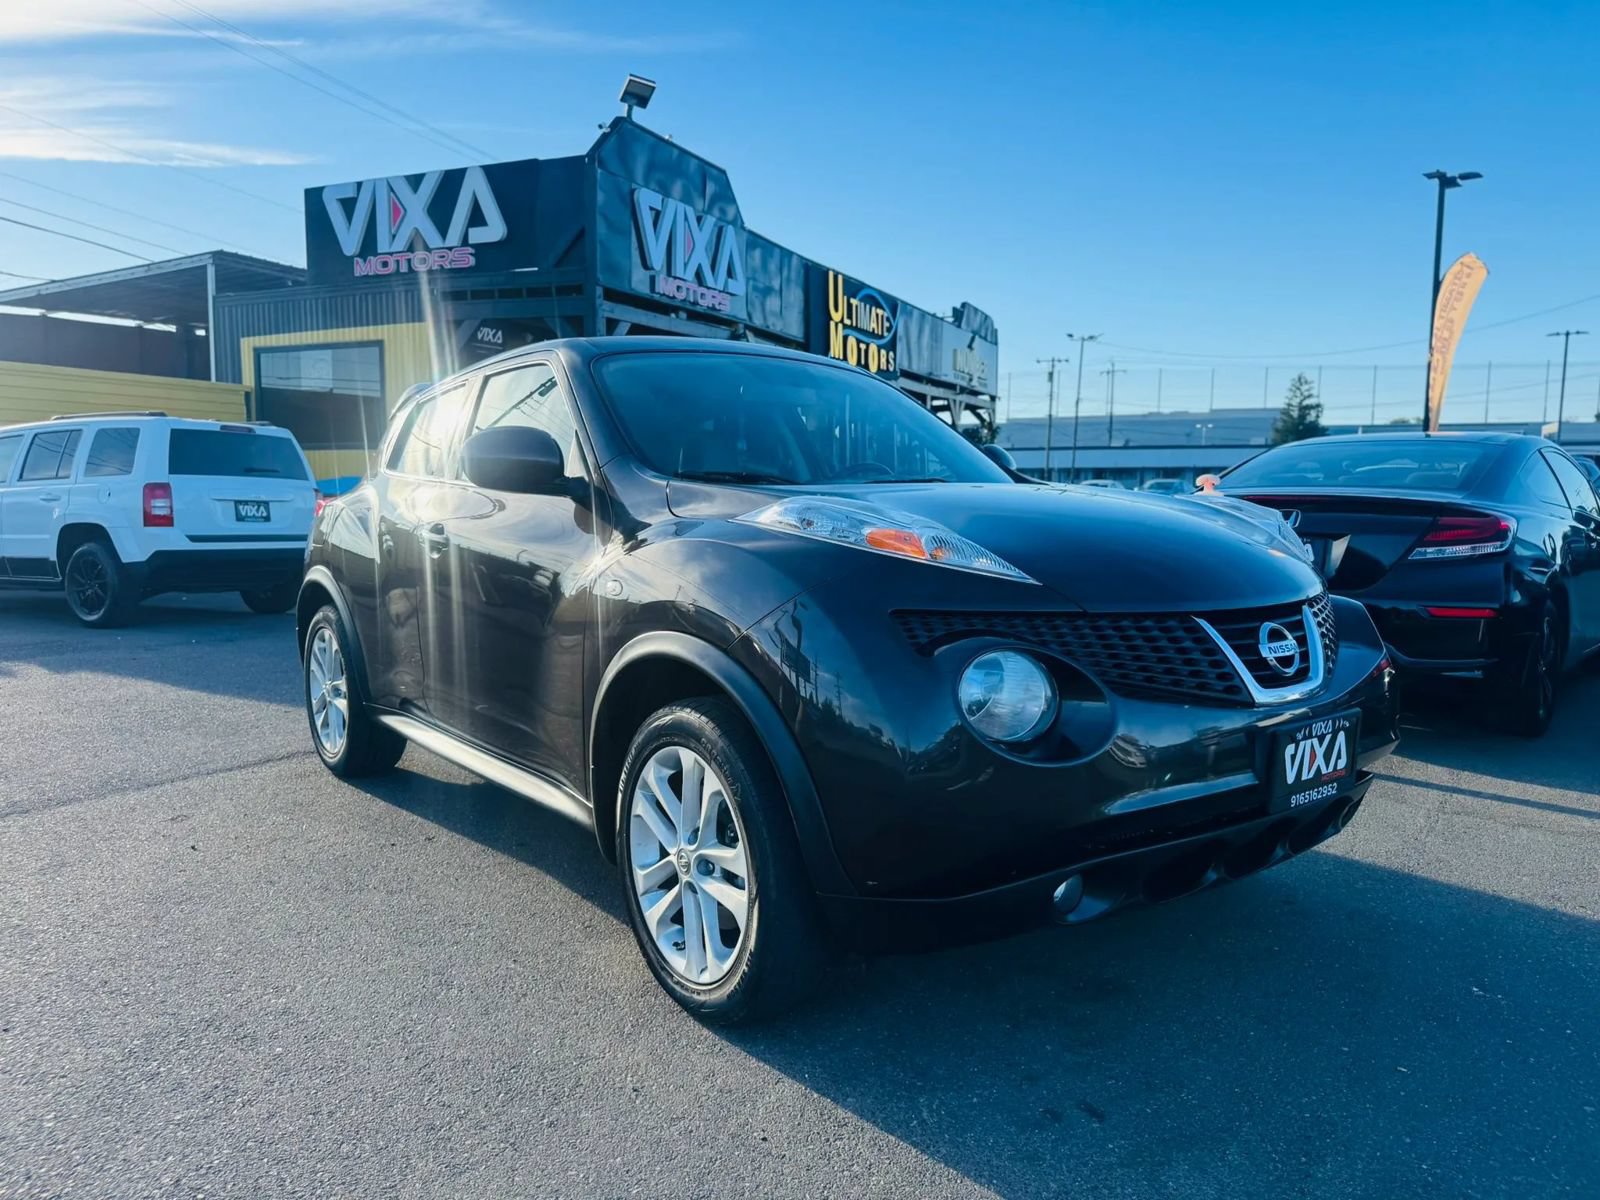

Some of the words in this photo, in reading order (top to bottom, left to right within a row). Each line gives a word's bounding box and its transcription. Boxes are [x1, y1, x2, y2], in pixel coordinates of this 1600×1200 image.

[322, 165, 507, 257] VIXA
[633, 187, 746, 296] VIXA
[354, 246, 476, 277] MOTORS
[659, 275, 731, 312] MOTORS
[477, 327, 503, 343] VIXA
[829, 320, 895, 373] MOTORS
[238, 504, 267, 517] VIXA
[1284, 730, 1348, 785] VIXA
[1290, 782, 1338, 807] 9165162952
